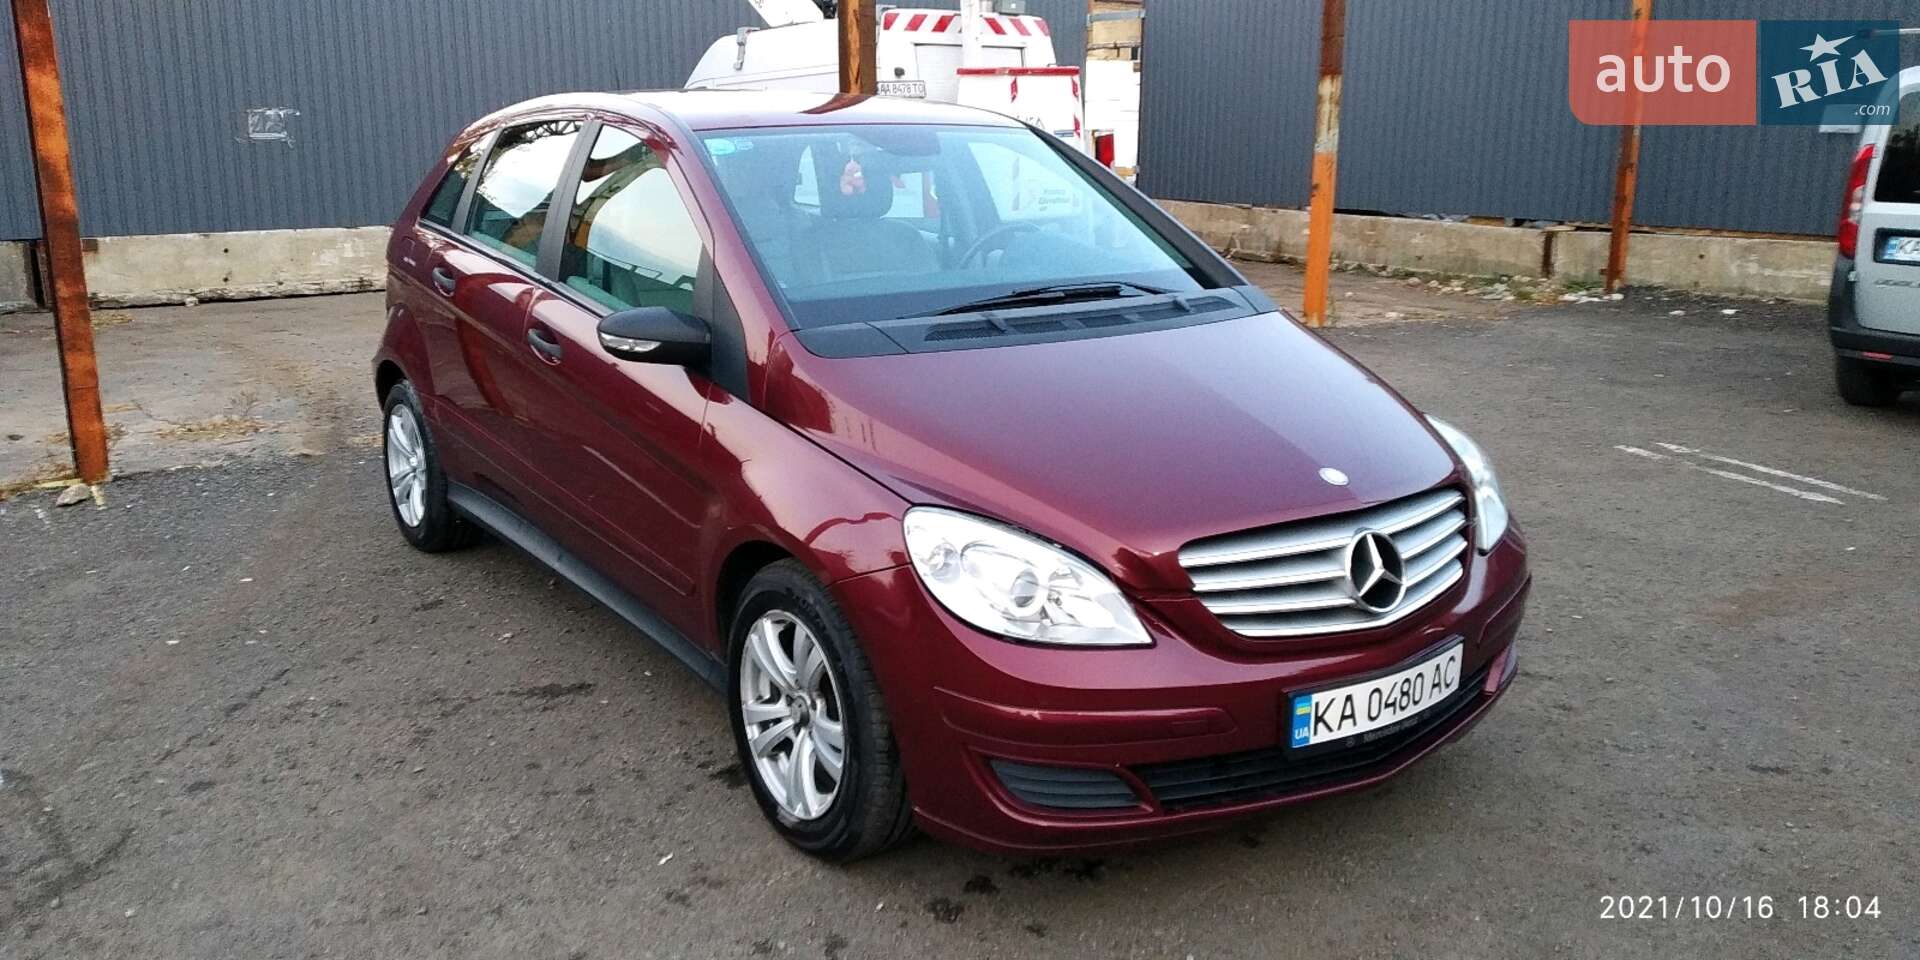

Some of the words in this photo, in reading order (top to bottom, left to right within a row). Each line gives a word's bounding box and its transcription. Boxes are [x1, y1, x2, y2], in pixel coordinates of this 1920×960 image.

[1313, 693, 1358, 736] KA
[1367, 672, 1424, 722] 0480
[1429, 655, 1455, 699] AC
[1294, 728, 1310, 740] UA
